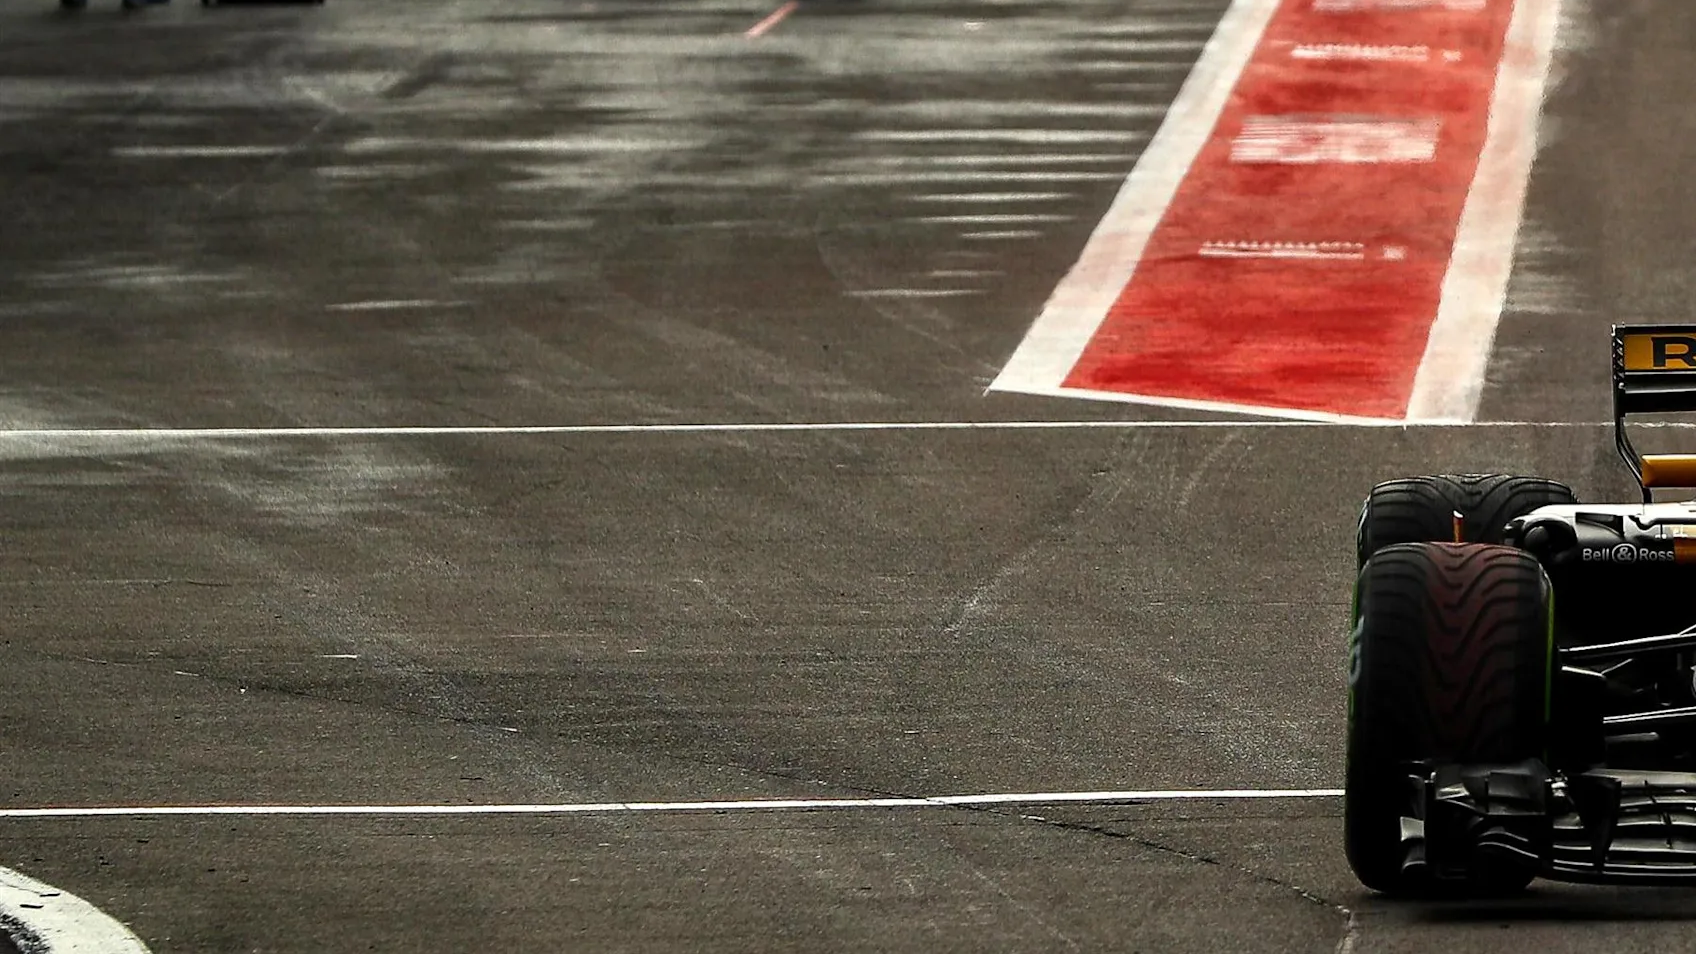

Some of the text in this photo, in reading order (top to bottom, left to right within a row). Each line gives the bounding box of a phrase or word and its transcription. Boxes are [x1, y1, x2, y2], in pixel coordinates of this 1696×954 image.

[1582, 545, 1675, 562] Bell & Ross
